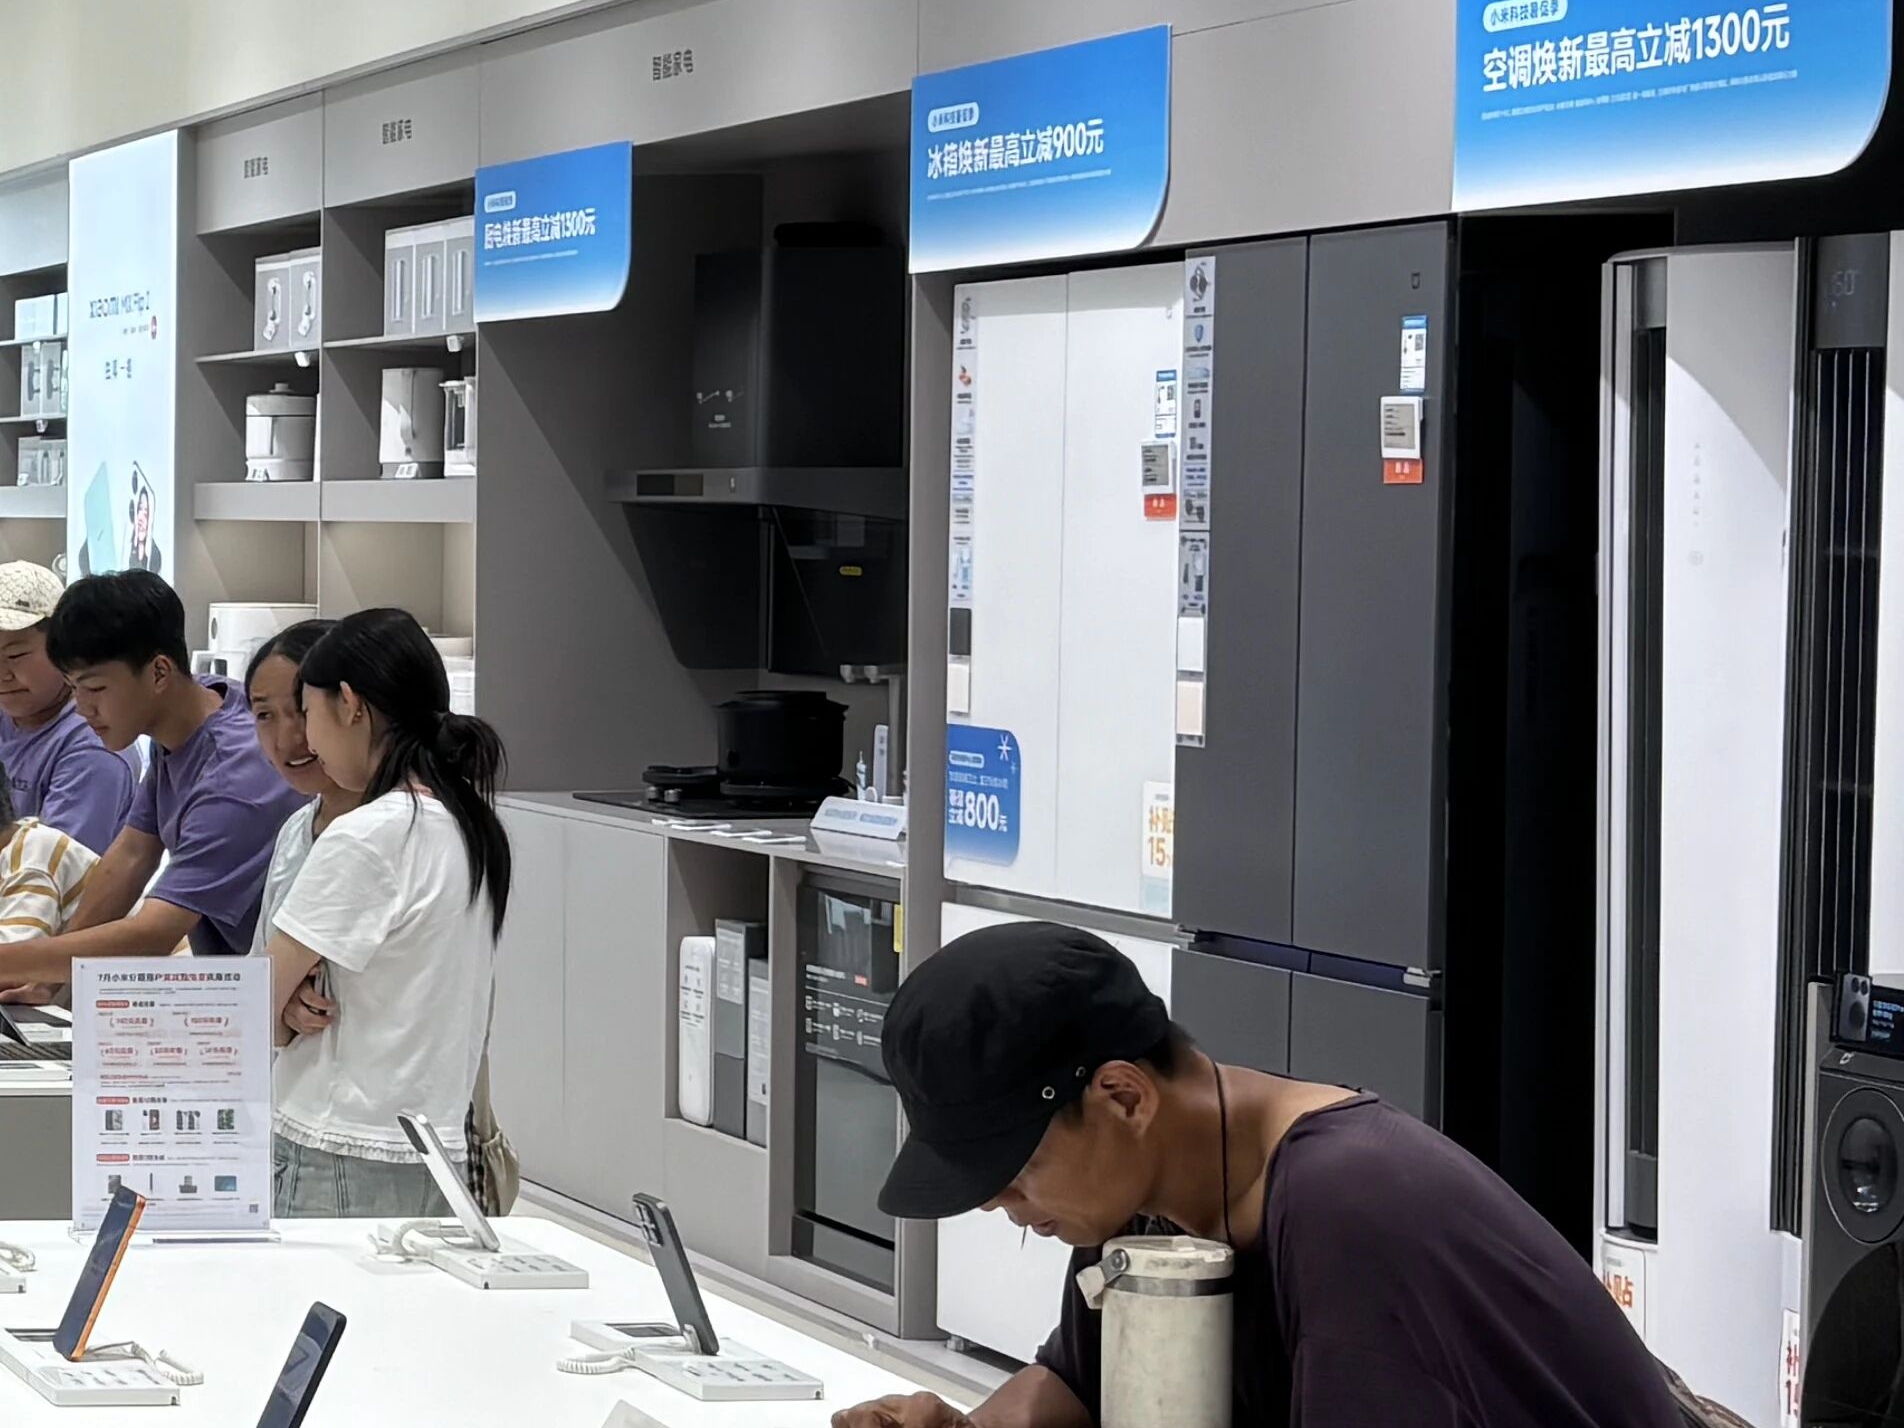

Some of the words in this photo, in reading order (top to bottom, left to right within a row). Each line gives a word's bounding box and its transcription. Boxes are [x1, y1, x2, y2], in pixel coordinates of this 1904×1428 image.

[1482, 2, 1791, 93] 空调焕新最高立减1300元
[927, 117, 1105, 180] 冰箱焕新最高立减900元
